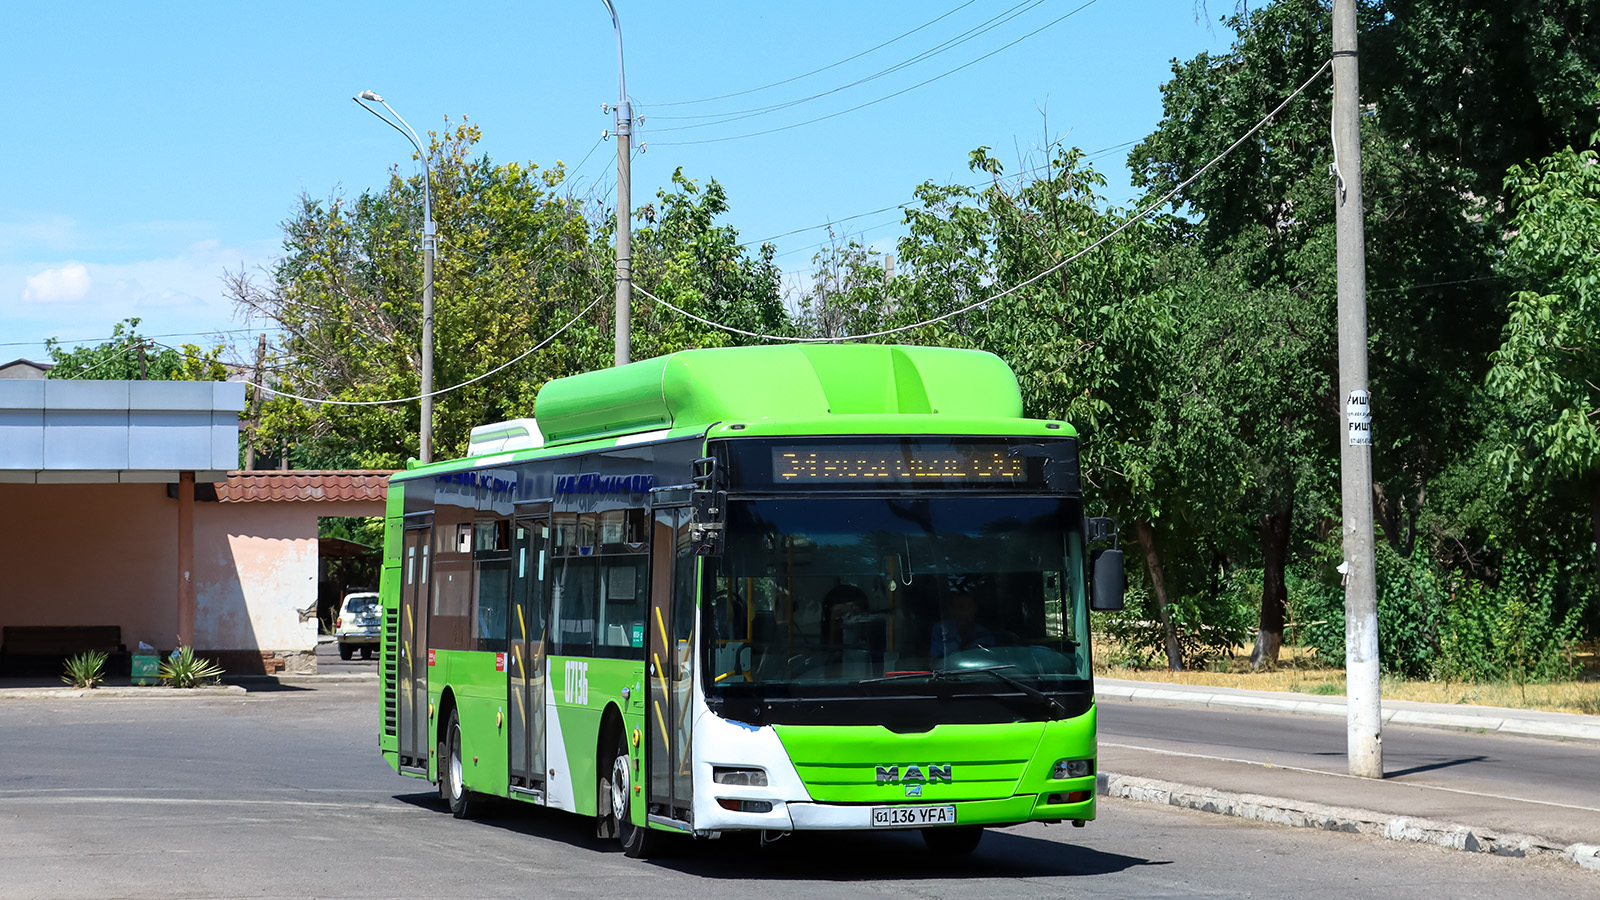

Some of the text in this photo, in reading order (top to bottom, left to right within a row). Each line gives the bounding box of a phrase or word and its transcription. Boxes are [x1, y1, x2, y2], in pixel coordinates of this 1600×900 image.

[565, 660, 589, 706] 07136
[875, 764, 952, 783] MAN
[875, 811, 889, 823] 01
[891, 809, 916, 824] 136
[919, 808, 947, 822] YFA
